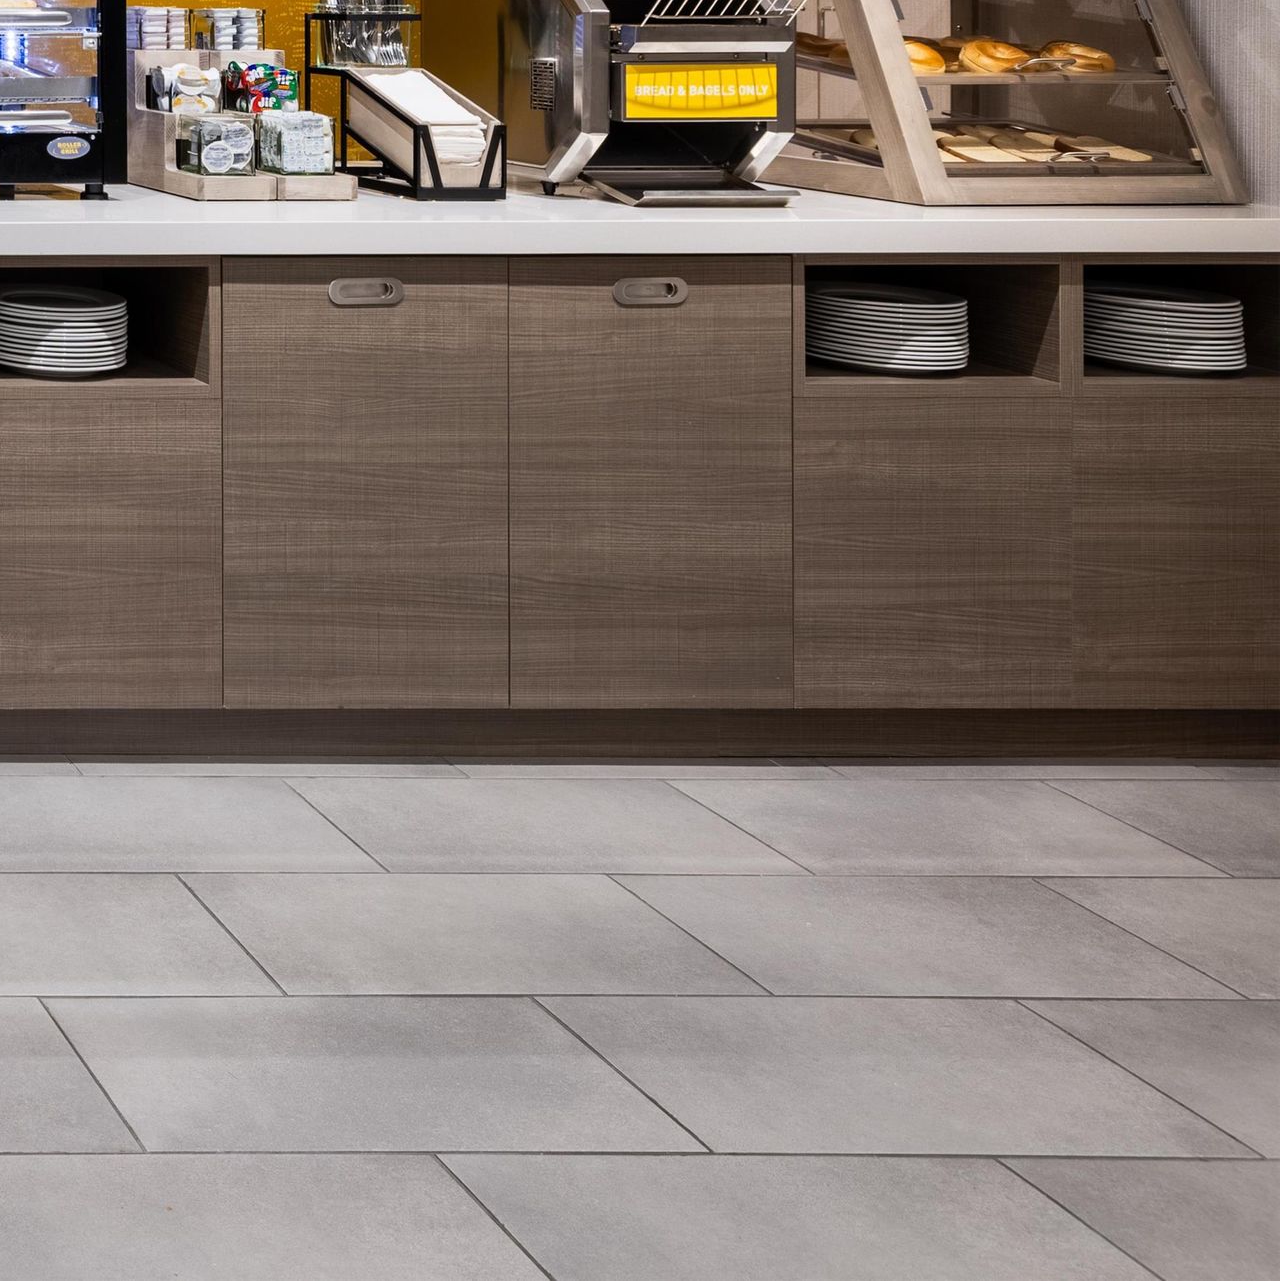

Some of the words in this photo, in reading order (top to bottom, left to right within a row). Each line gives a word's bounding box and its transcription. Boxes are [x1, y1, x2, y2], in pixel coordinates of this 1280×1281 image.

[635, 85, 674, 96] BREAD
[677, 86, 687, 96] &
[688, 85, 735, 96] BAGELS
[738, 85, 768, 96] ONLY
[258, 96, 277, 108] Jif
